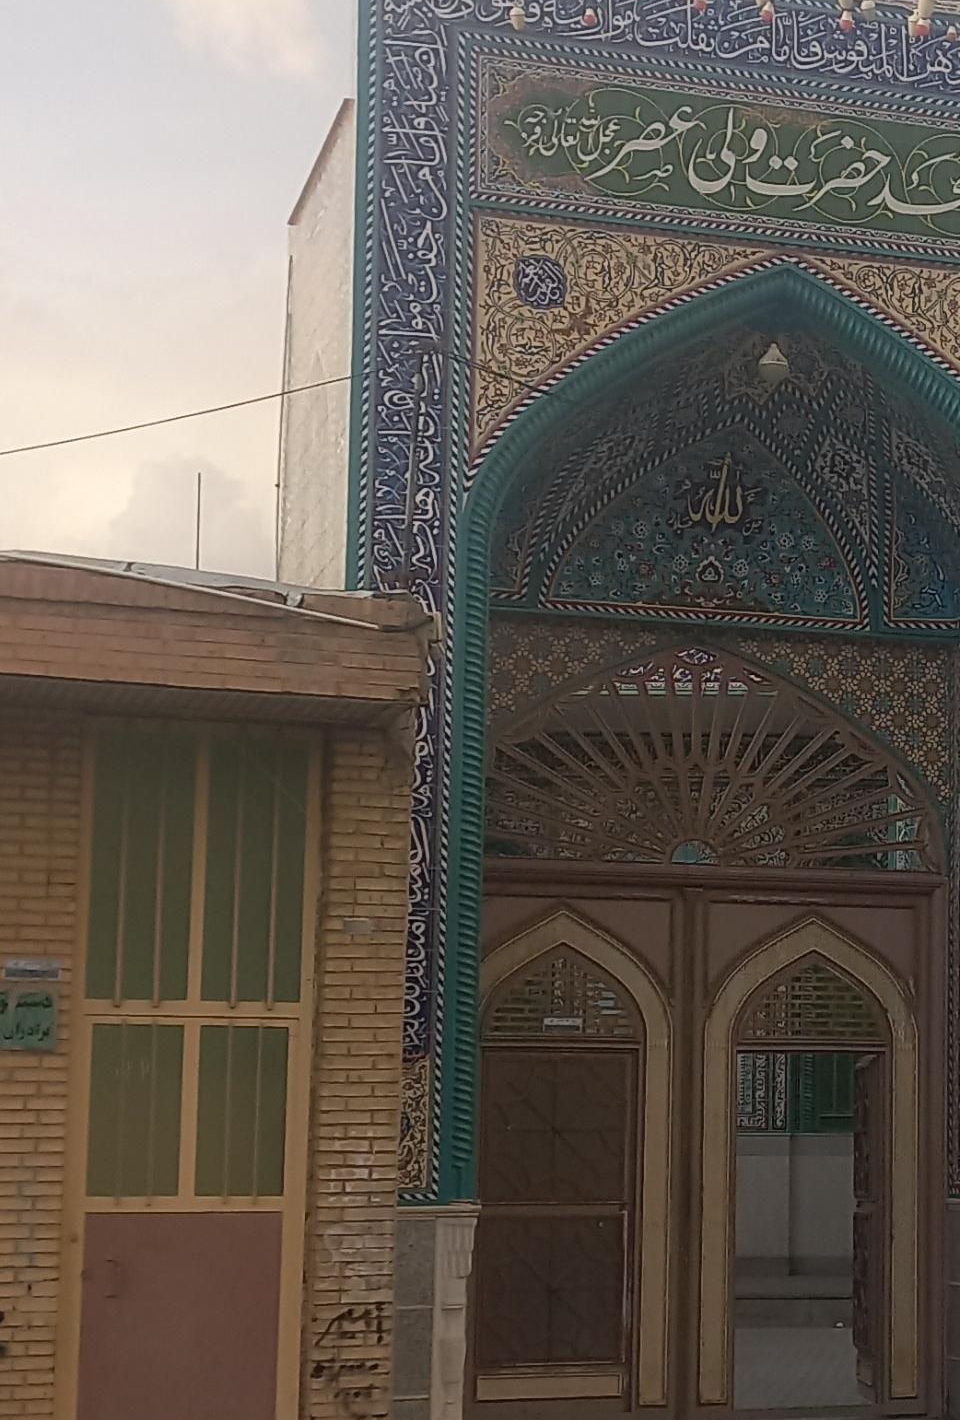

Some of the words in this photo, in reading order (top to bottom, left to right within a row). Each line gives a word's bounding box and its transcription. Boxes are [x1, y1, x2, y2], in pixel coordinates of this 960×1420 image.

[584, 105, 707, 181] عصر
[688, 107, 768, 194] ولی
[746, 130, 892, 211] حضرت
